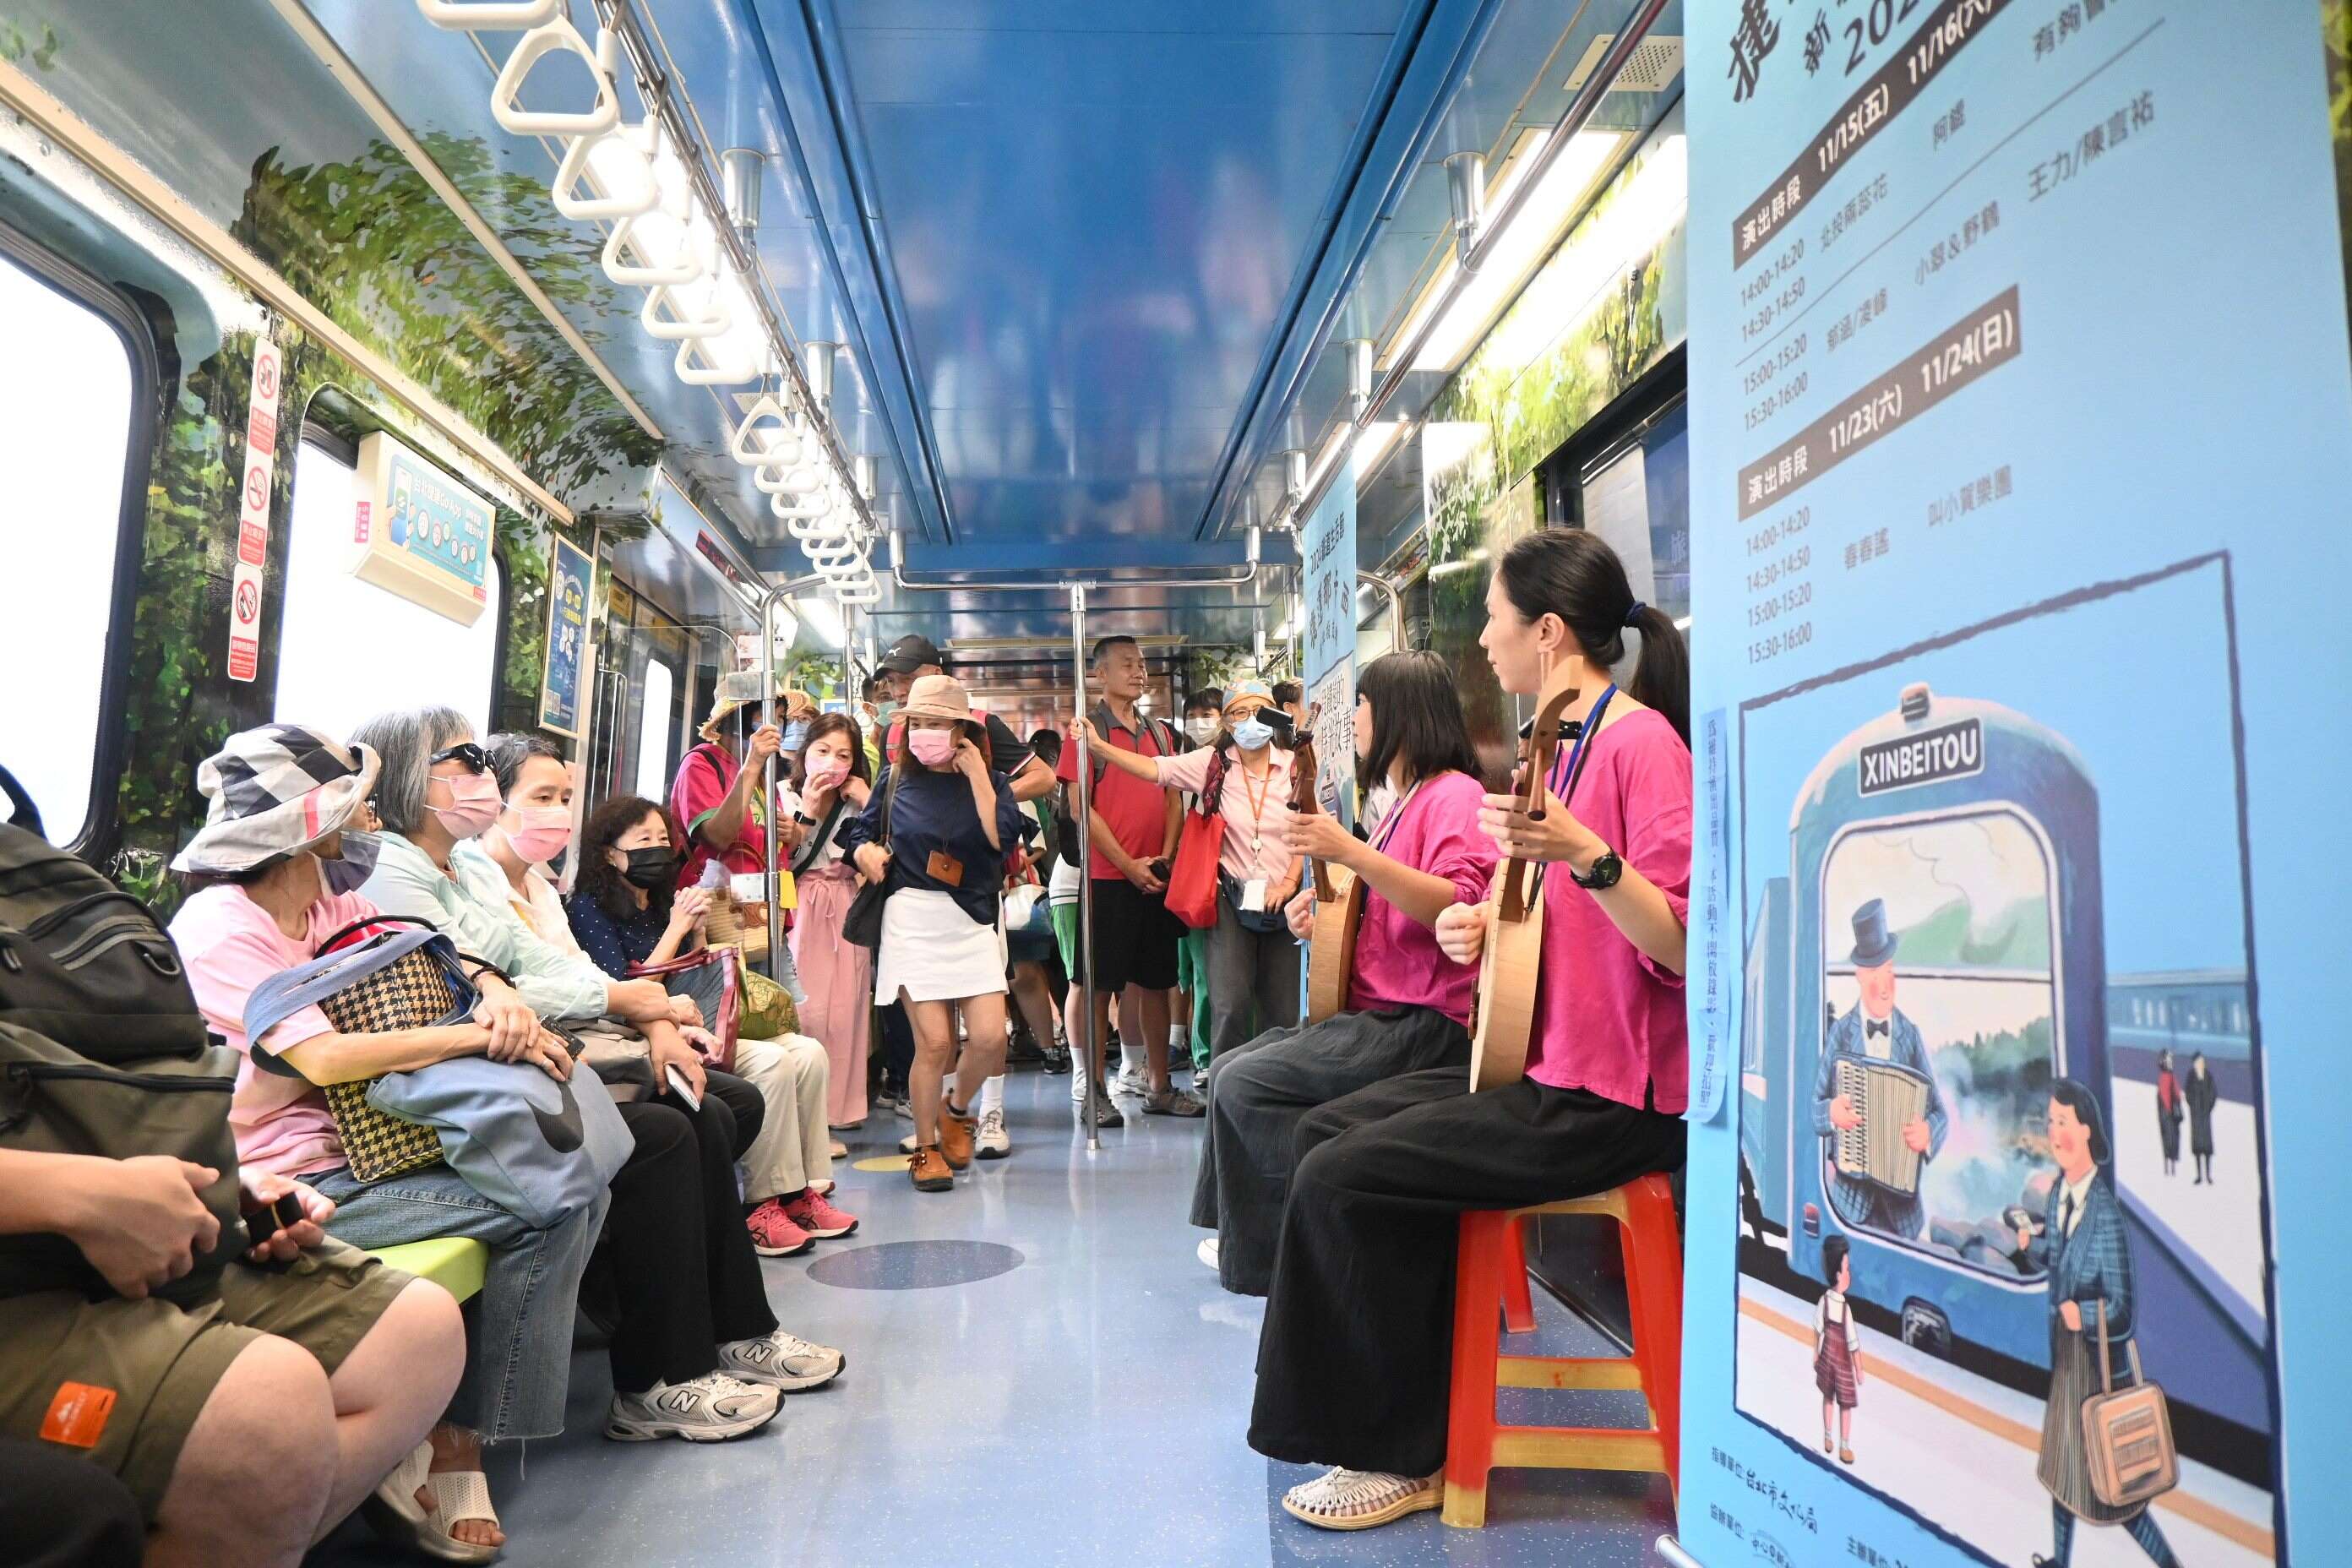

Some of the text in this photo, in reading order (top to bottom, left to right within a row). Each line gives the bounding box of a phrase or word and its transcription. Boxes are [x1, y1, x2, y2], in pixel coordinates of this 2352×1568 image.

[1741, 173, 1802, 252] 演出時段
[1817, 83, 1890, 172] 11/15(五)
[1740, 237, 1805, 308] 14:00-14:20
[1741, 276, 1805, 342] 14:30-14:50
[1743, 332, 1808, 396] 15:00-15:20
[1744, 371, 1809, 432] 15:30-16:00
[1748, 308, 2014, 505] 演出時段 11/23(六) 11/24(日)
[1745, 505, 1810, 558] 14:00-14:20
[1746, 545, 1810, 593] 14:30-14:50
[1747, 581, 1812, 628] 15:00-15:20
[1748, 621, 1812, 665] 15:30-16:00
[1864, 727, 1978, 787] XINBEITOU
[670, 1391, 700, 1413] N
